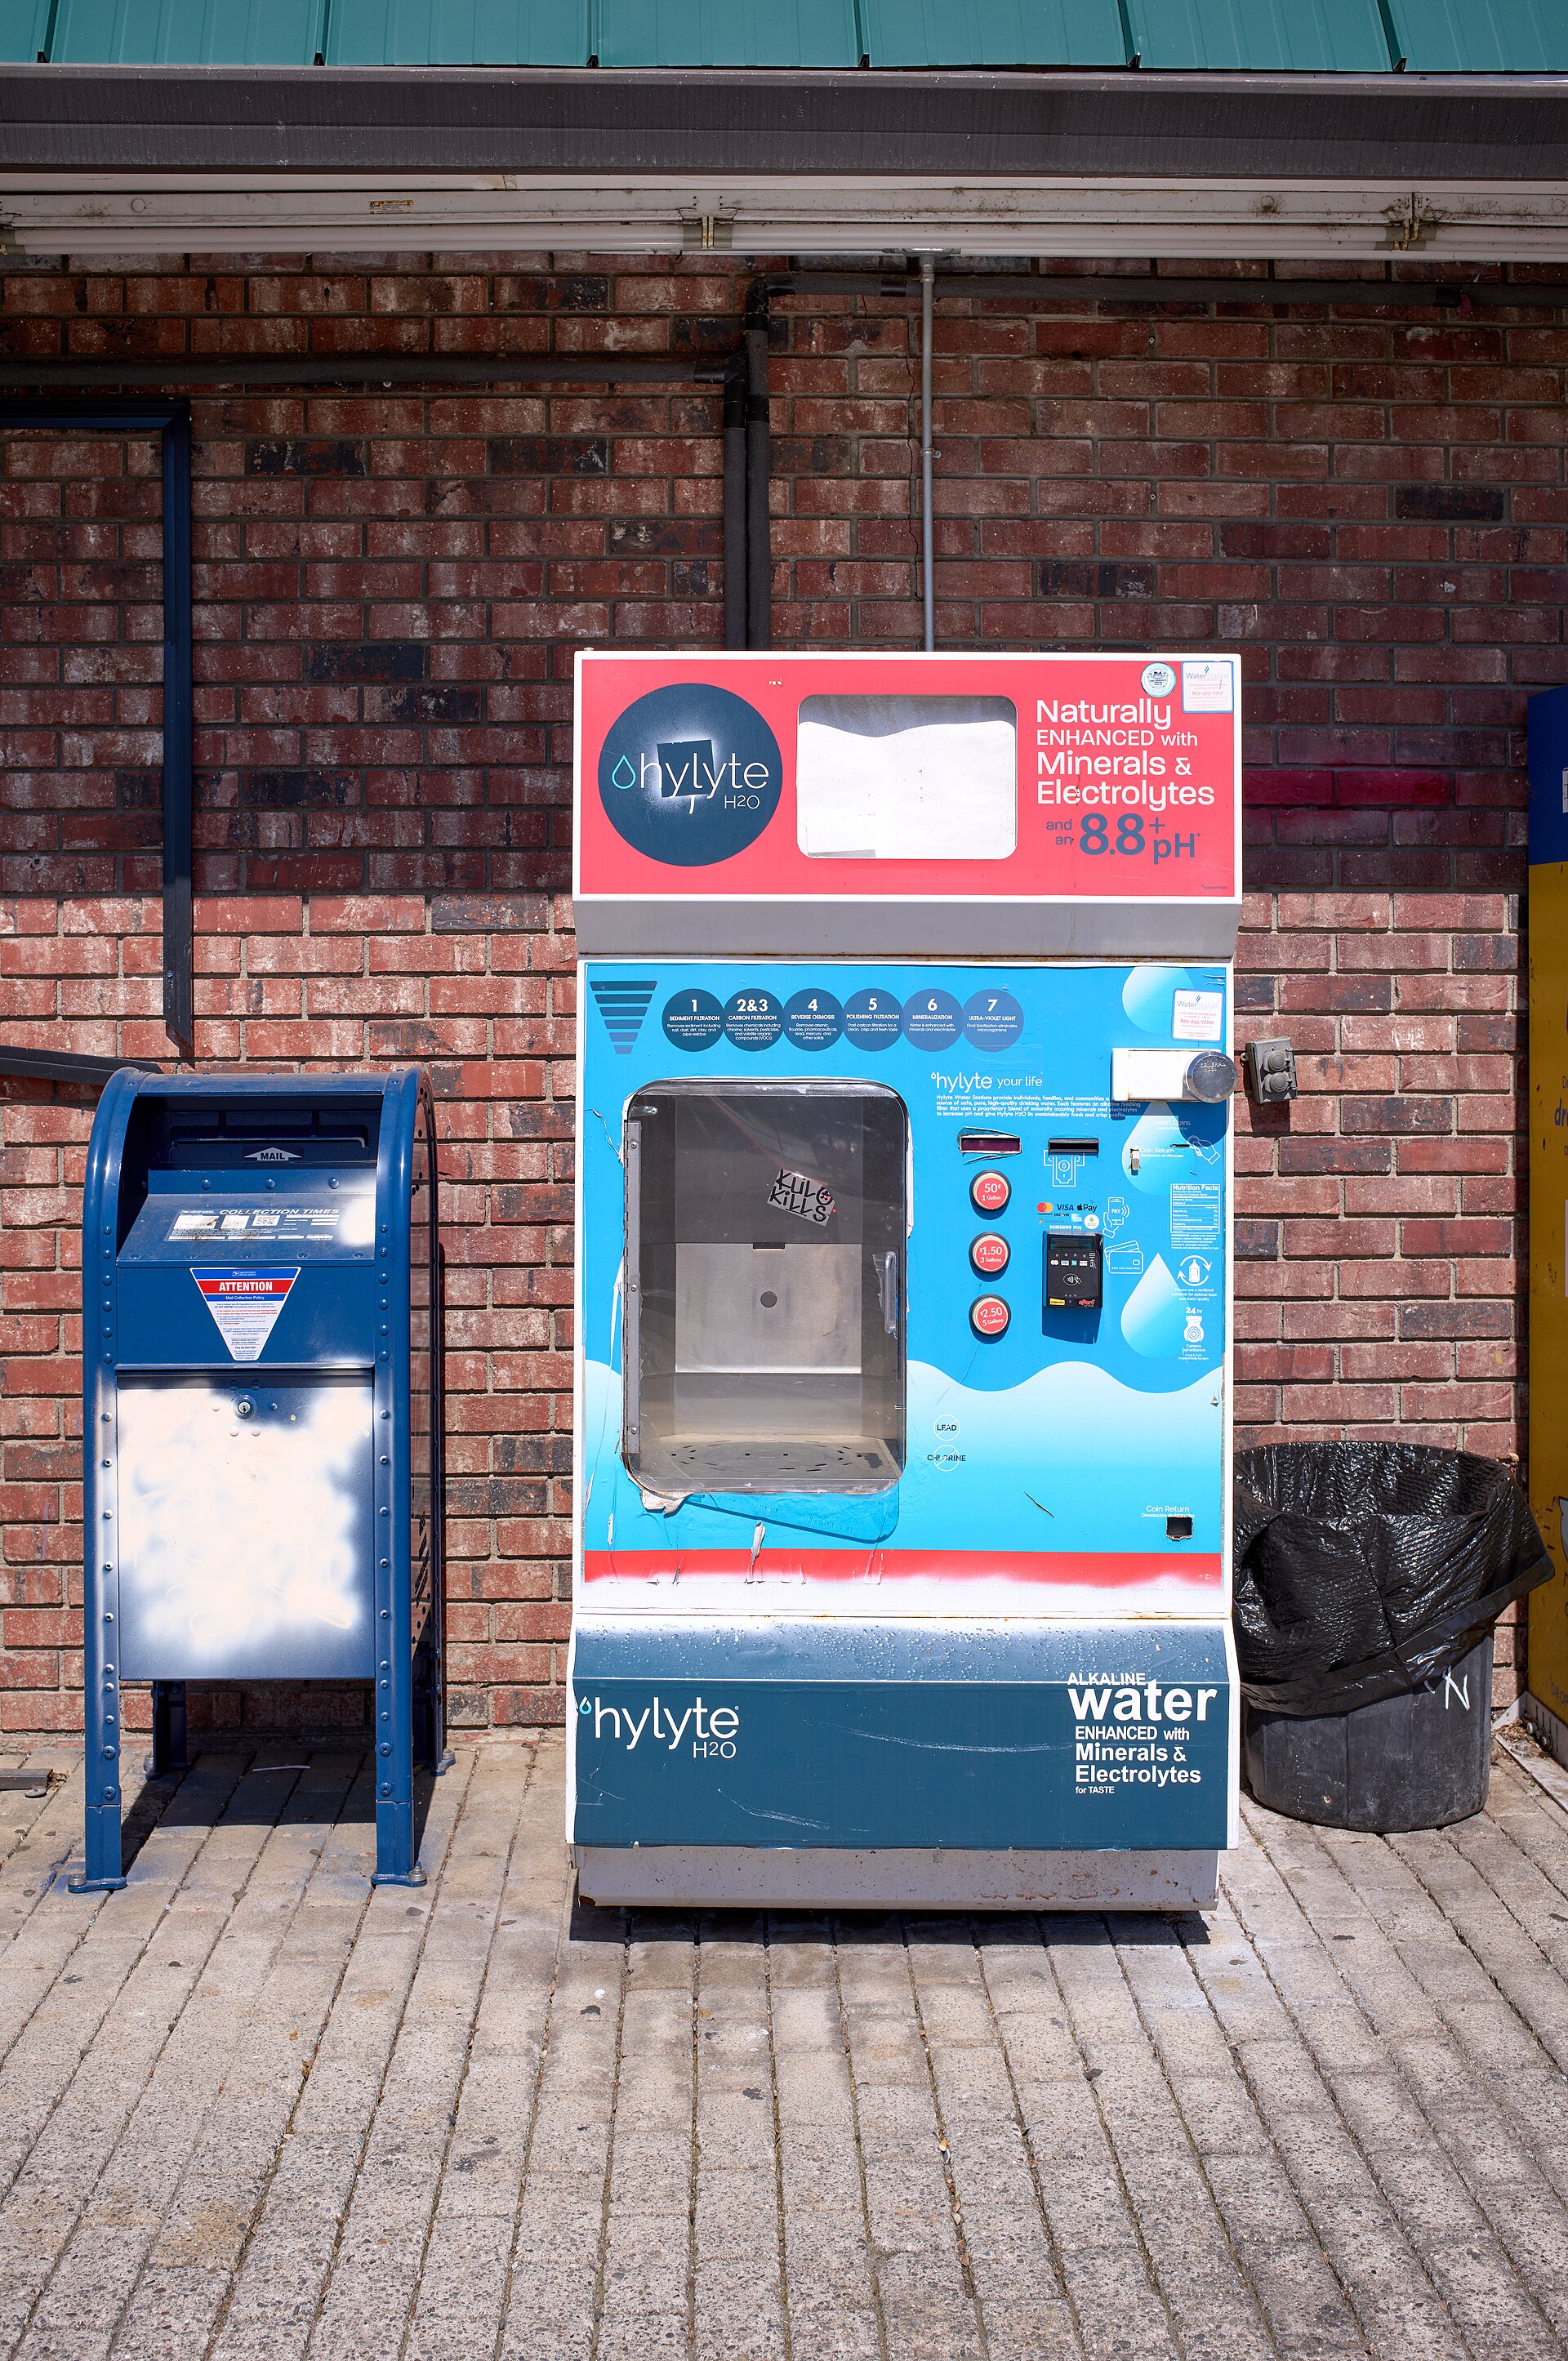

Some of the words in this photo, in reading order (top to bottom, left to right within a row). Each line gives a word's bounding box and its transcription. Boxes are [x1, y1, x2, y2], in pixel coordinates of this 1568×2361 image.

[1036, 698, 1171, 730] Naturally
[1036, 729, 1154, 746] ENHANCED
[1160, 732, 1198, 746] with
[1037, 750, 1166, 775] Minerals
[1174, 757, 1192, 775] &
[640, 752, 769, 799] hylyte
[724, 795, 760, 809] H2O
[1037, 778, 1215, 812] Electrolytes
[1045, 819, 1072, 831] and
[1055, 835, 1072, 845] an
[691, 999, 697, 1013] 1
[737, 999, 768, 1012] 2&3
[808, 998, 817, 1012] 4
[868, 998, 878, 1011] 5
[928, 998, 938, 1012] 6
[987, 999, 998, 1012] 7
[936, 1072, 992, 1093] hylyte
[997, 1078, 1022, 1089] your
[1025, 1076, 1042, 1086] life
[984, 1183, 1002, 1193] 50¢
[1083, 1205, 1097, 1213] Pay
[979, 1246, 1003, 1255] $1.50
[218, 1281, 273, 1292] ATTENTION
[980, 1307, 1003, 1318] $2.50
[1067, 1672, 1147, 1686] ALKALINE
[1067, 1678, 1218, 1722] water
[1075, 1726, 1158, 1740] ENHANCED
[1163, 1726, 1190, 1740] with
[693, 1741, 737, 1758] H2O
[1076, 1742, 1169, 1762] Minerals
[1173, 1746, 1187, 1762] &
[1076, 1764, 1201, 1788] Electrolytes
